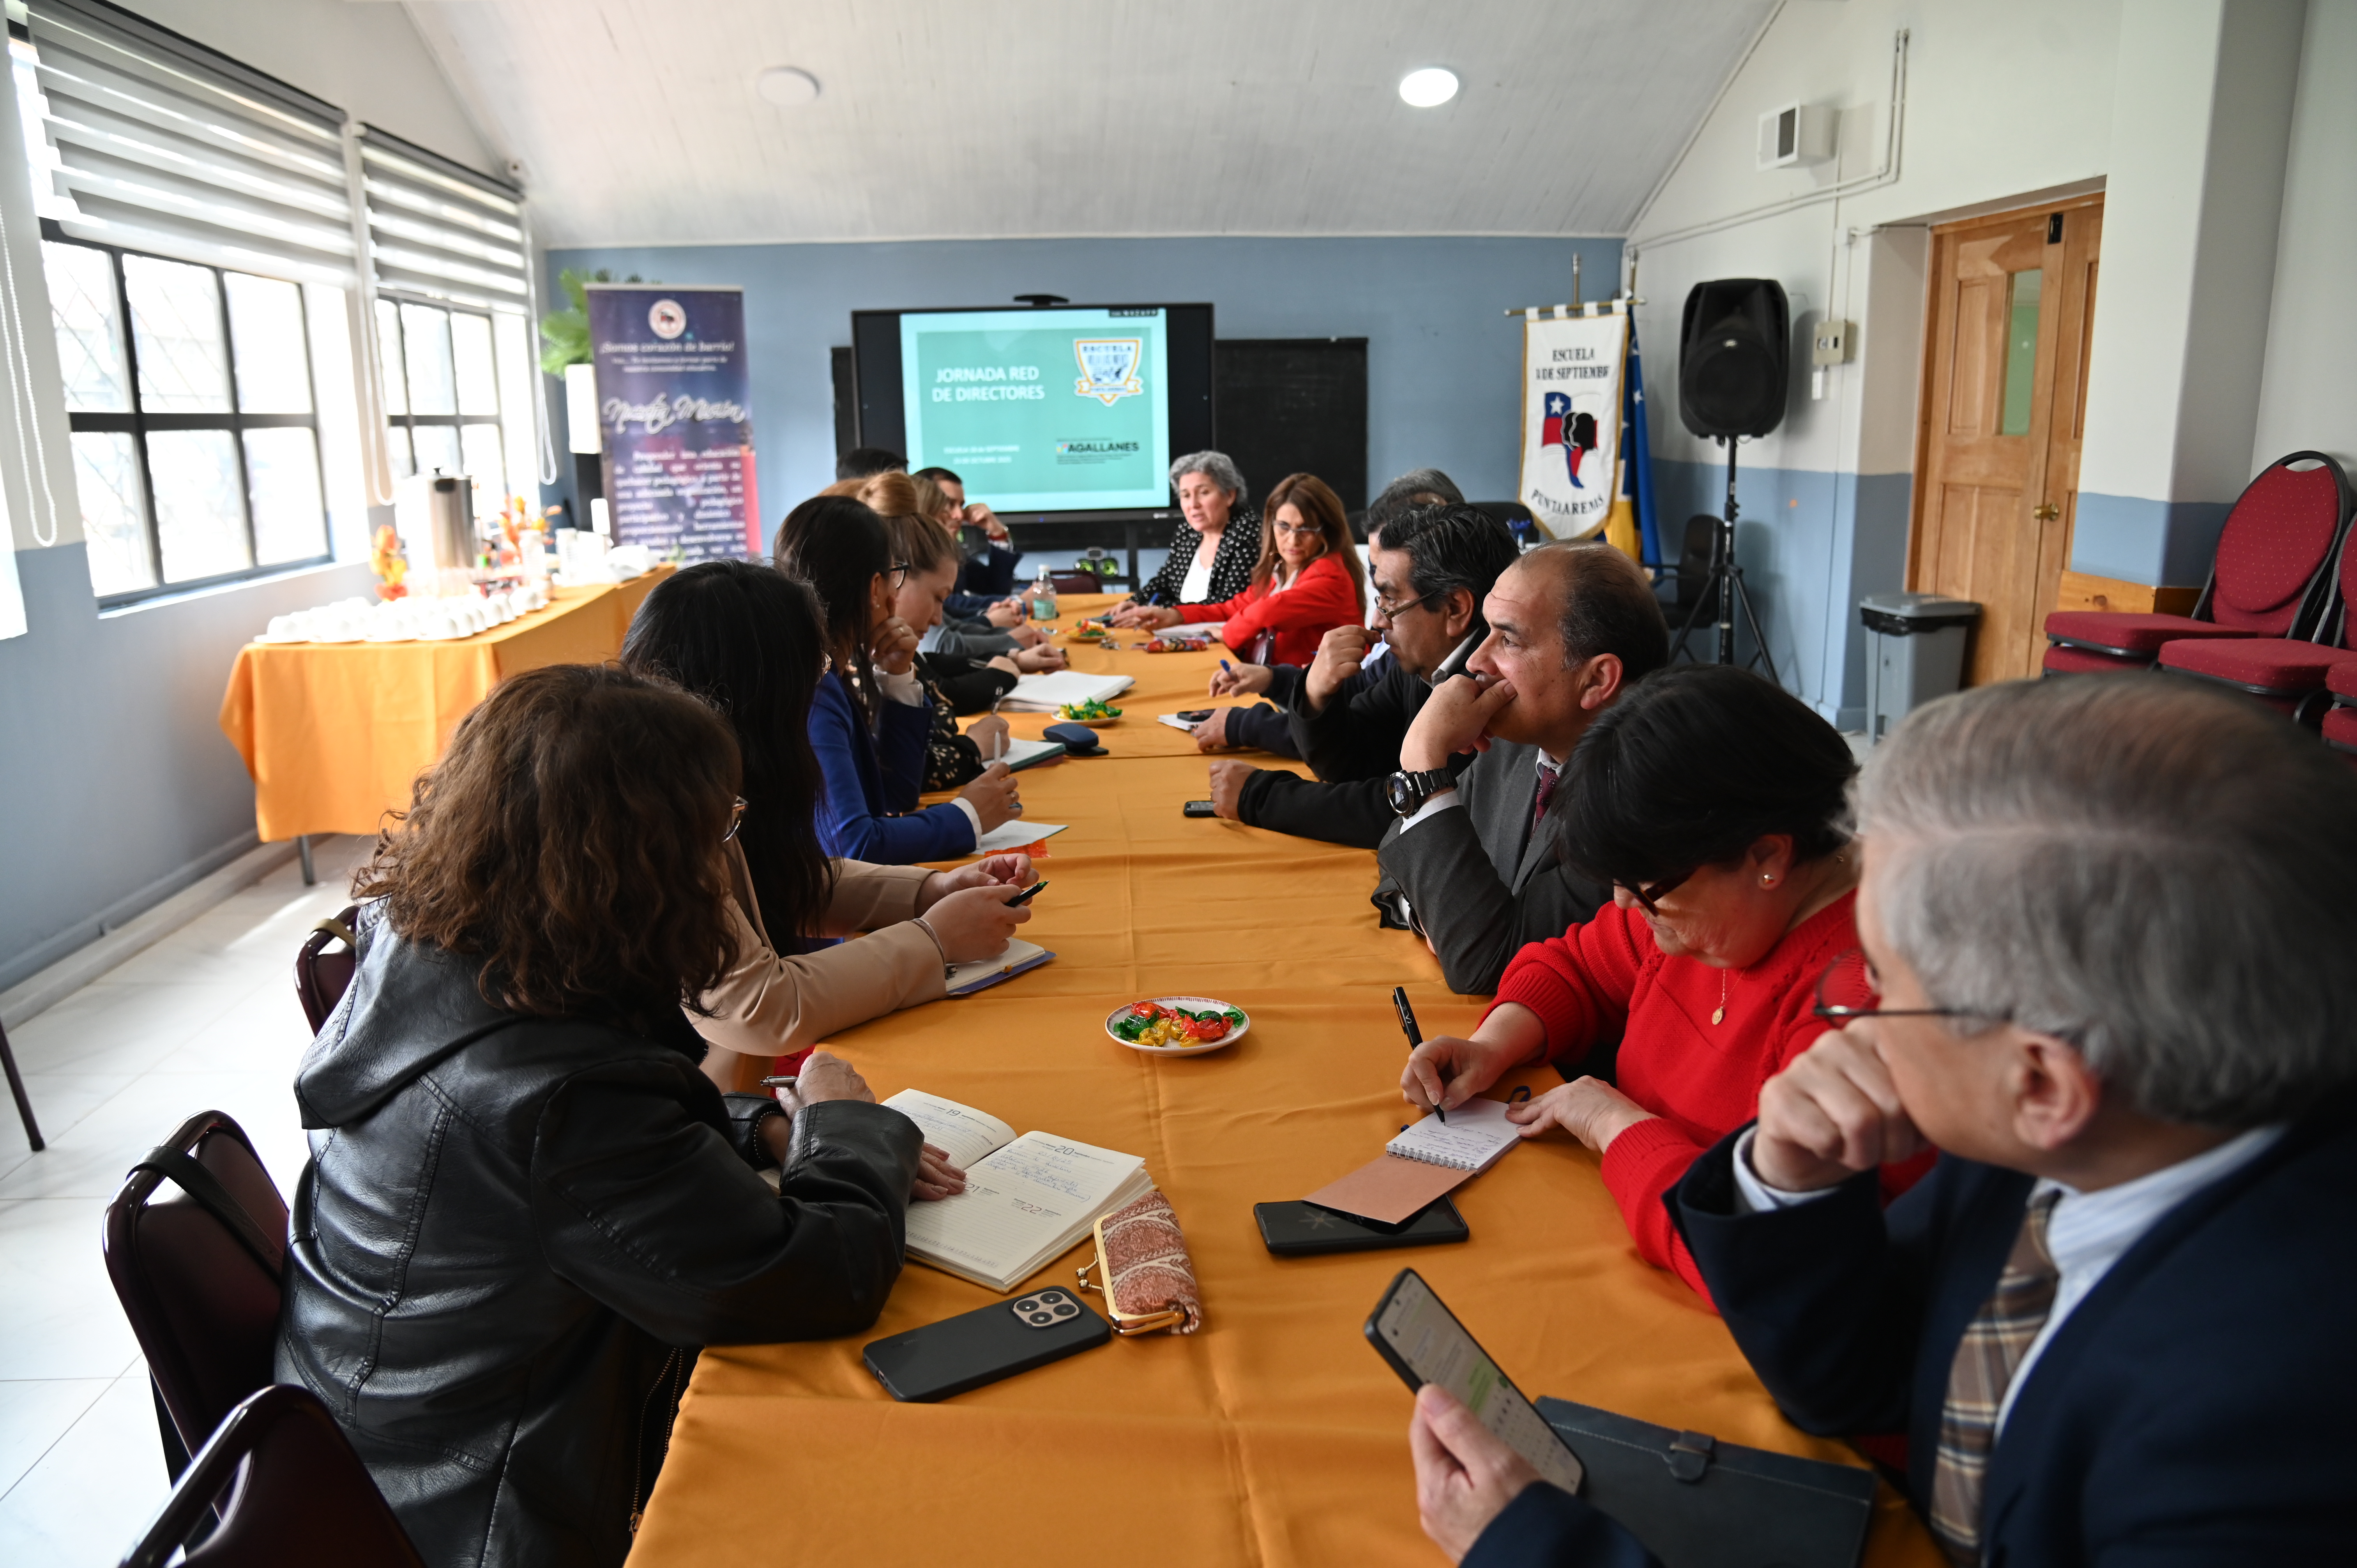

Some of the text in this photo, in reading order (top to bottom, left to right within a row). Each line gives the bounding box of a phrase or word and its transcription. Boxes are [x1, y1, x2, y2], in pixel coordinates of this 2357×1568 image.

[1552, 348, 1595, 362] ESCUELA
[935, 366, 1039, 383] JORNADA RED
[932, 384, 1045, 402] DE DIRECTORES
[1055, 1145, 1074, 1155] 20
[965, 1183, 980, 1193] 21
[1021, 1203, 1042, 1214] 22
